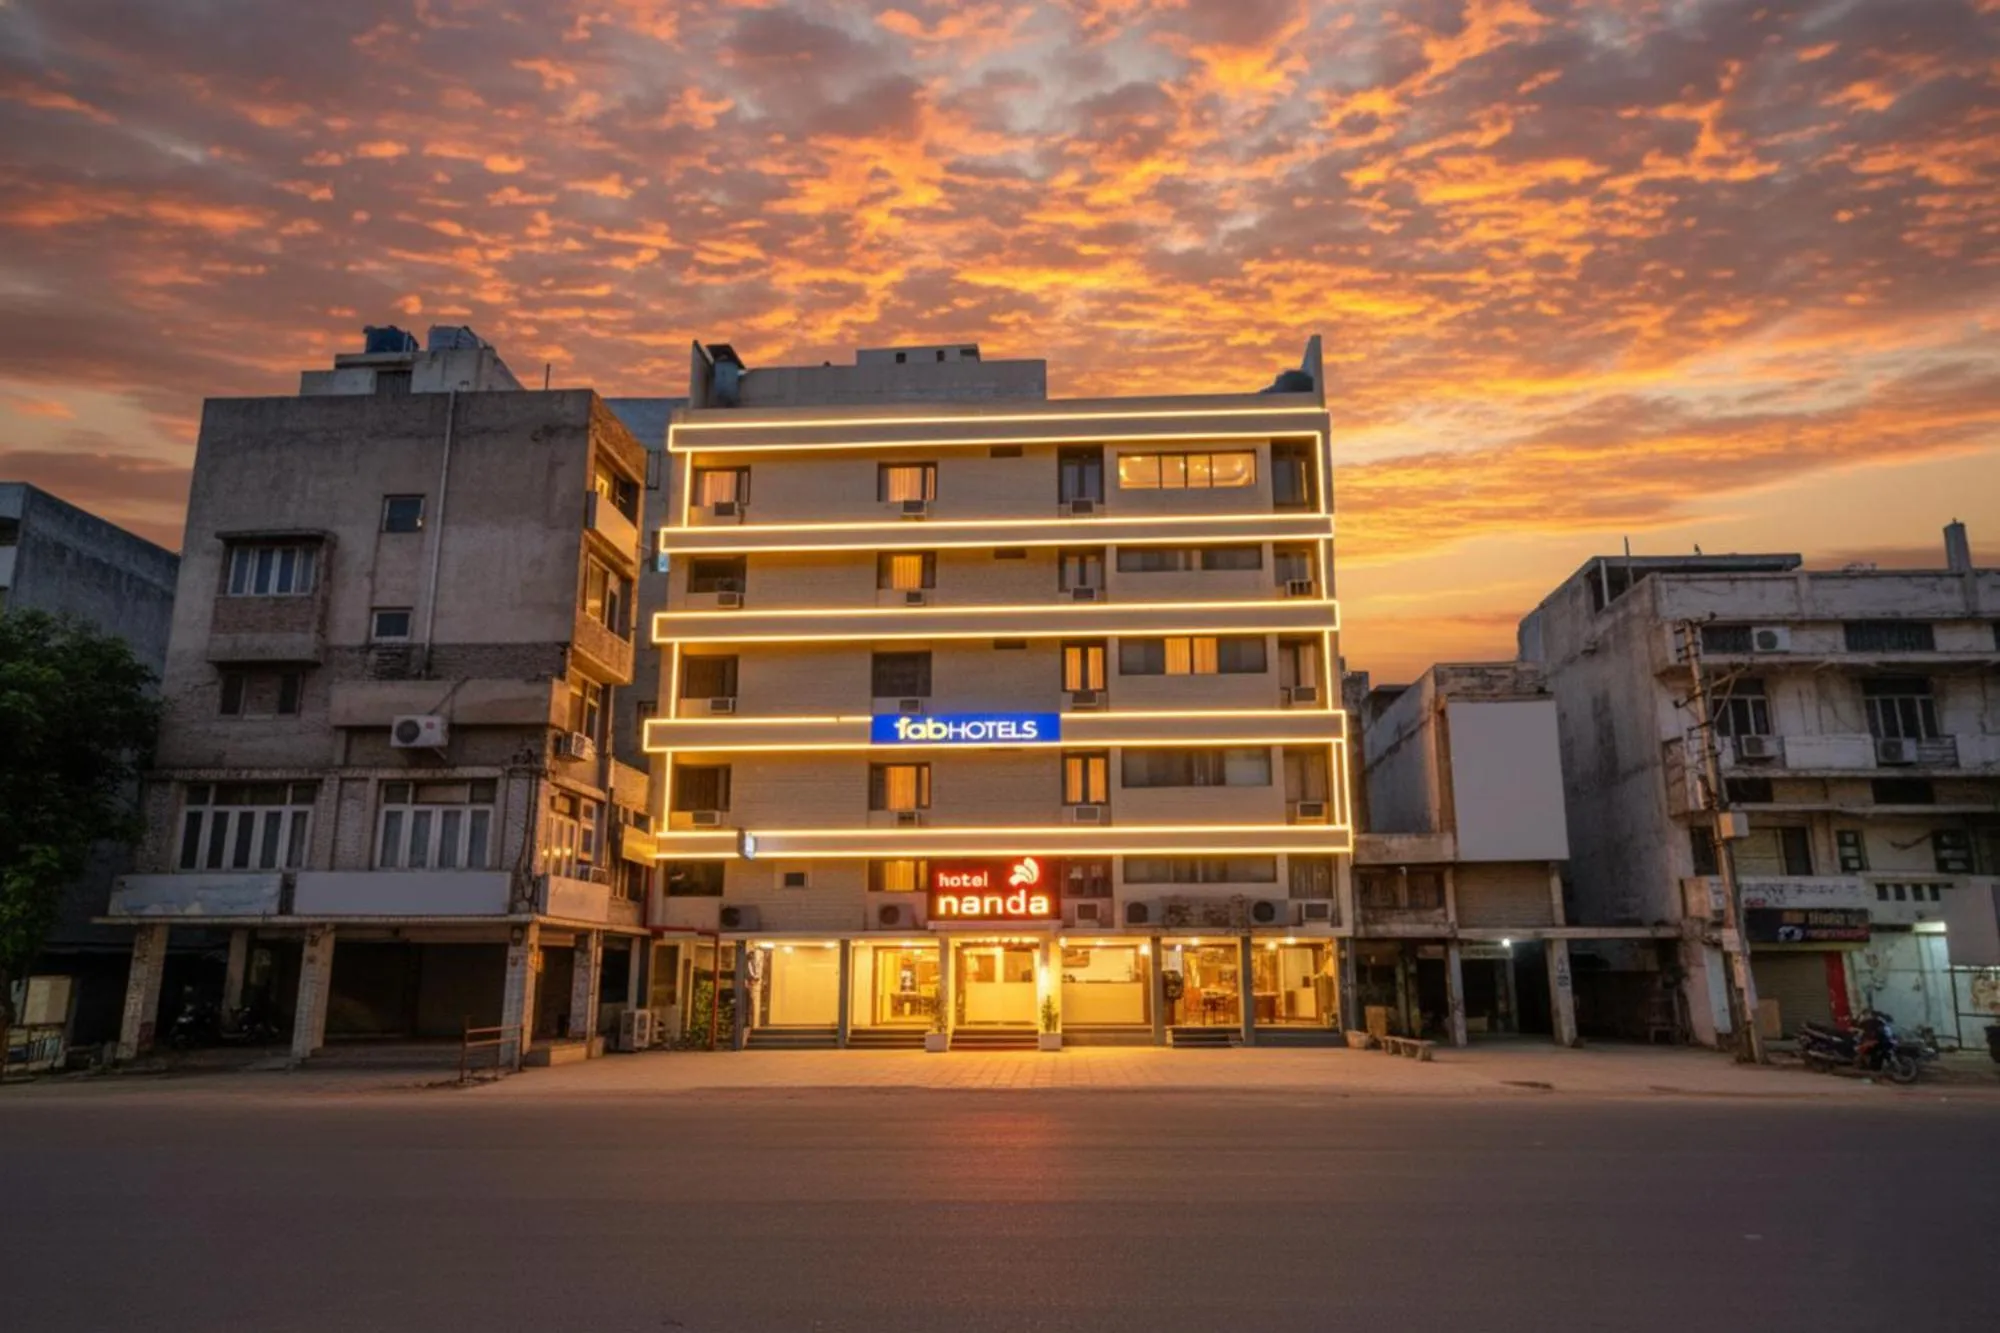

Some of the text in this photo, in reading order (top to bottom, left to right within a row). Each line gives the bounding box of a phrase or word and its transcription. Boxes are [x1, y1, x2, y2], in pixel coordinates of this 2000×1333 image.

[893, 716, 1038, 740] fabHOTELS
[938, 872, 988, 888] hotel
[938, 889, 1049, 915] nanda
